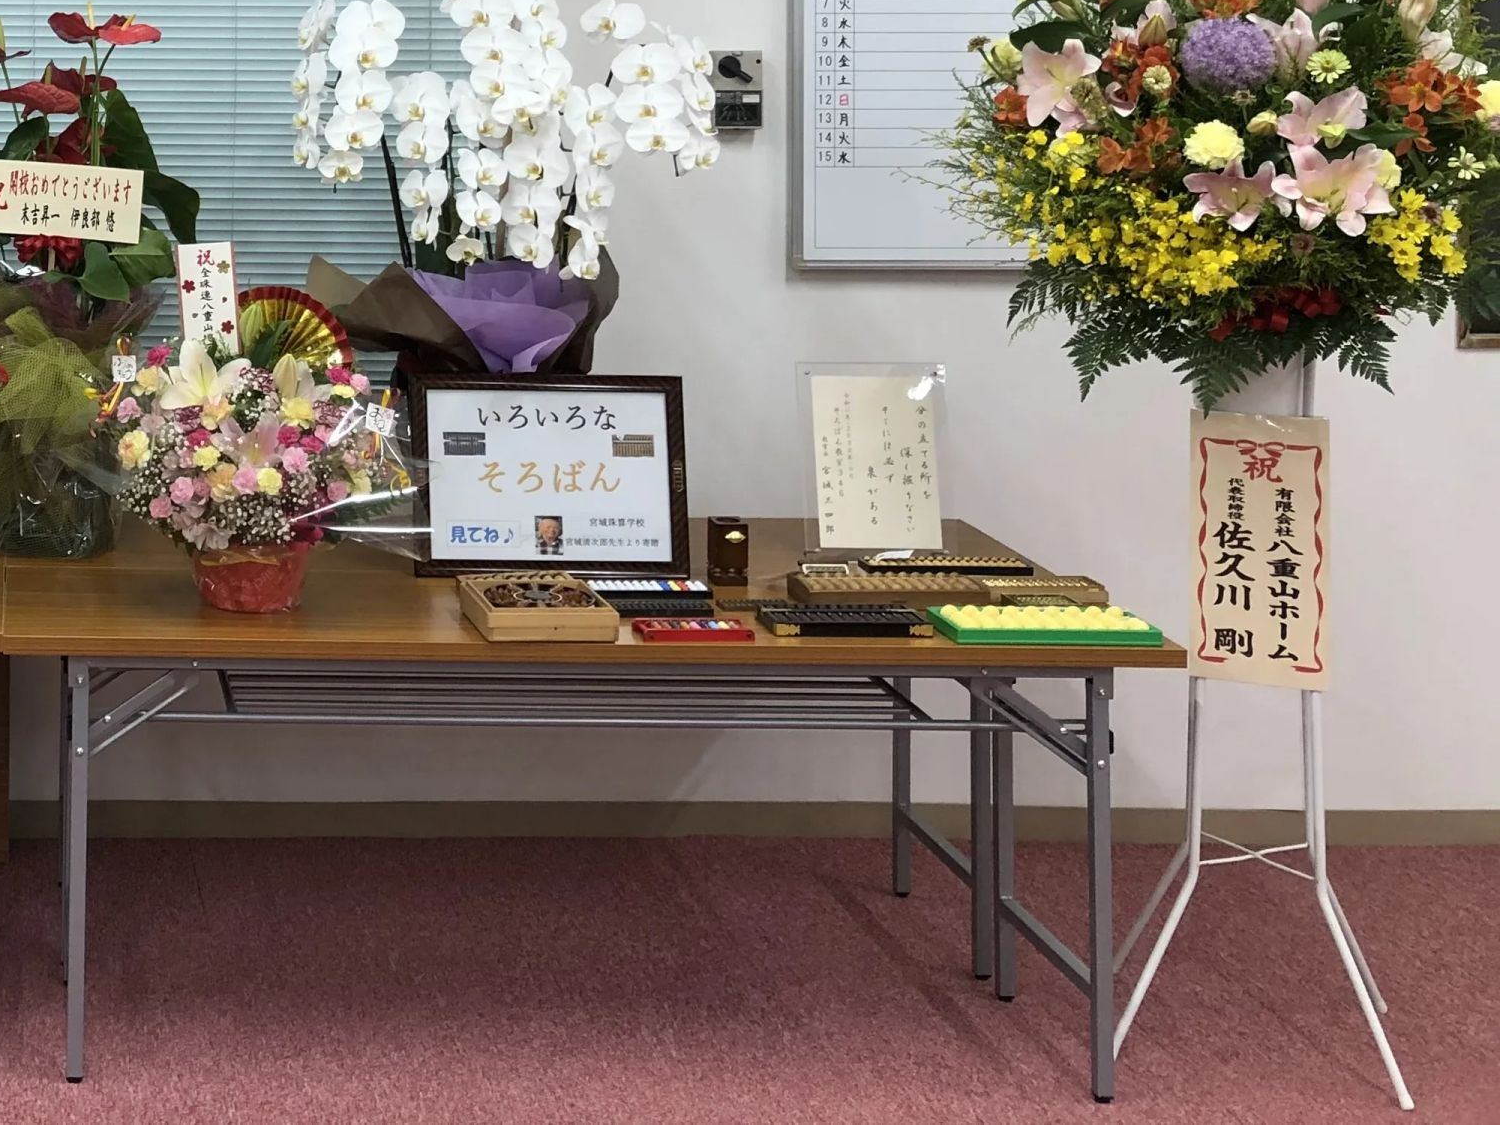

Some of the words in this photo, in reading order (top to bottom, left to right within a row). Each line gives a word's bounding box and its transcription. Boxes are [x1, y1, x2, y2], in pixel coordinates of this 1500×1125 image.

[822, 0, 828, 9] 7
[822, 17, 828, 29] 8
[838, 17, 852, 29] 水
[822, 36, 828, 48] 9
[838, 35, 852, 49] 木
[818, 56, 832, 67] 10
[838, 54, 850, 67] 金
[818, 75, 831, 86] 11
[838, 75, 852, 86] 土
[818, 95, 832, 105] 12
[840, 93, 849, 106] 日
[818, 113, 832, 123] 13
[840, 113, 849, 127] 月
[818, 133, 832, 143] 14
[838, 133, 850, 145] 火
[818, 151, 832, 162] 15
[838, 151, 851, 164] 水
[8, 169, 133, 206] 開校おめでとうございます
[196, 249, 215, 267] 祝
[476, 405, 616, 431] いろいろな
[1242, 454, 1284, 483] 祝
[477, 460, 621, 494] そろばん
